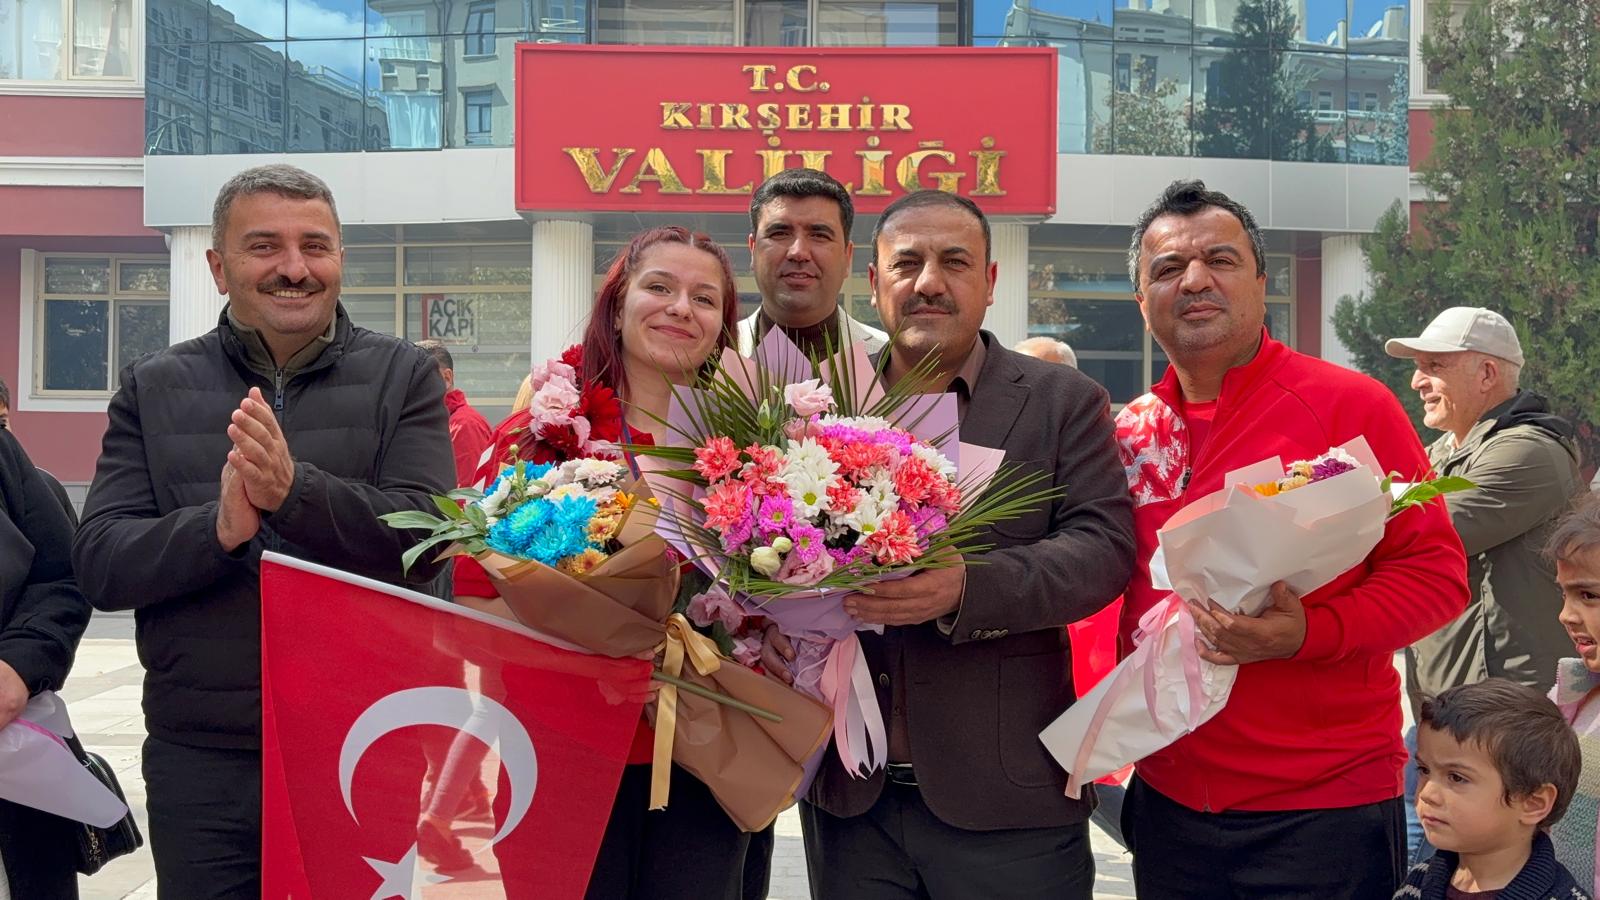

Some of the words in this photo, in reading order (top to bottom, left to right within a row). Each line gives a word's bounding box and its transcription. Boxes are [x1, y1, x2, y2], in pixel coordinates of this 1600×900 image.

[742, 64, 830, 92] T.C.
[660, 95, 913, 135] KIRŞEHİR
[429, 318, 474, 337] KAPI
